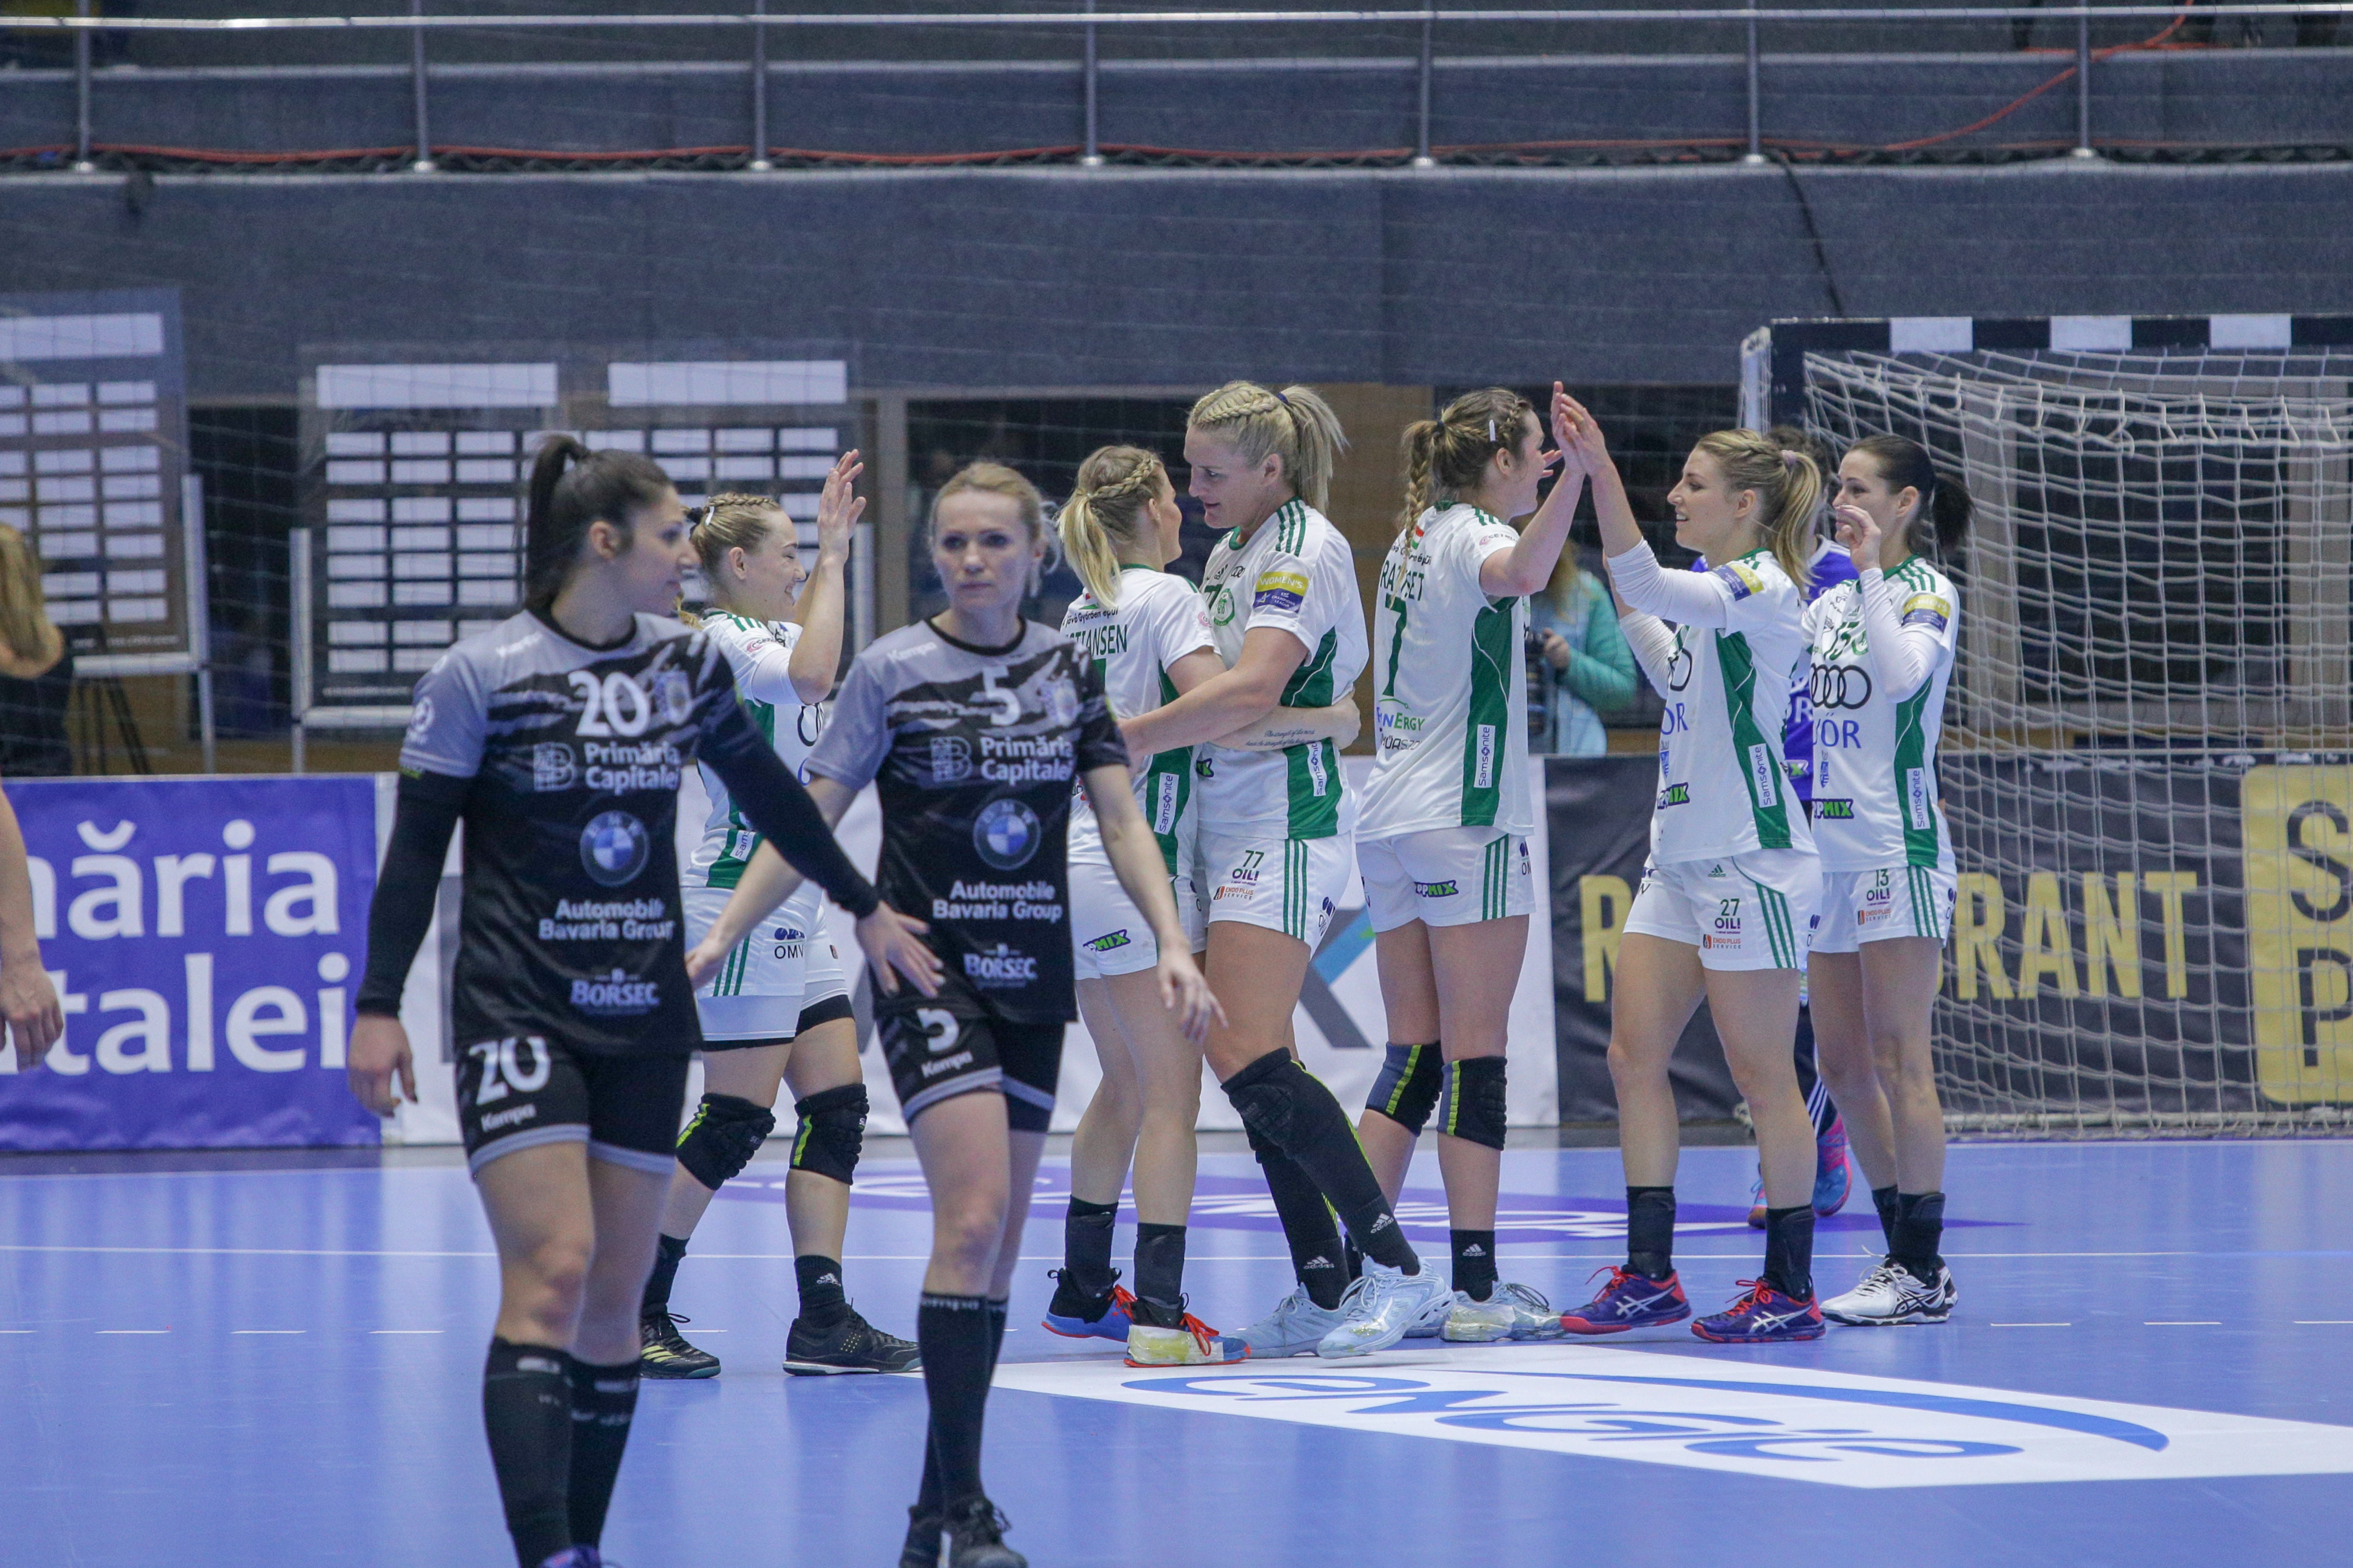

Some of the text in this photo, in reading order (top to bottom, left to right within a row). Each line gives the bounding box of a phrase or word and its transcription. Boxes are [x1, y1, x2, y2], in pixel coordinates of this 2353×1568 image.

[1261, 576, 1303, 588] WOMEN'S
[568, 670, 652, 737] 20
[981, 665, 1021, 726] 5
[1479, 726, 1491, 787] Samsonite
[1754, 746, 1772, 806] Samsonite
[1159, 775, 1174, 832] Samsonite
[1913, 769, 1925, 828] Samsonite
[1242, 850, 1265, 869] 77
[1232, 868, 1260, 881] OIL!
[1876, 869, 1889, 887] 13
[950, 879, 1056, 901] Automobile
[1866, 887, 1890, 902] OIL!
[932, 899, 1064, 923] Bavaria Group
[1720, 898, 1740, 917] 27
[539, 919, 619, 941] Bavaria
[1714, 917, 1741, 929] OIL!
[571, 979, 660, 1007] BORSEC
[469, 1036, 552, 1105] 20
[1370, 1218, 1395, 1234] adidas
[1304, 1262, 1335, 1270] adidas
